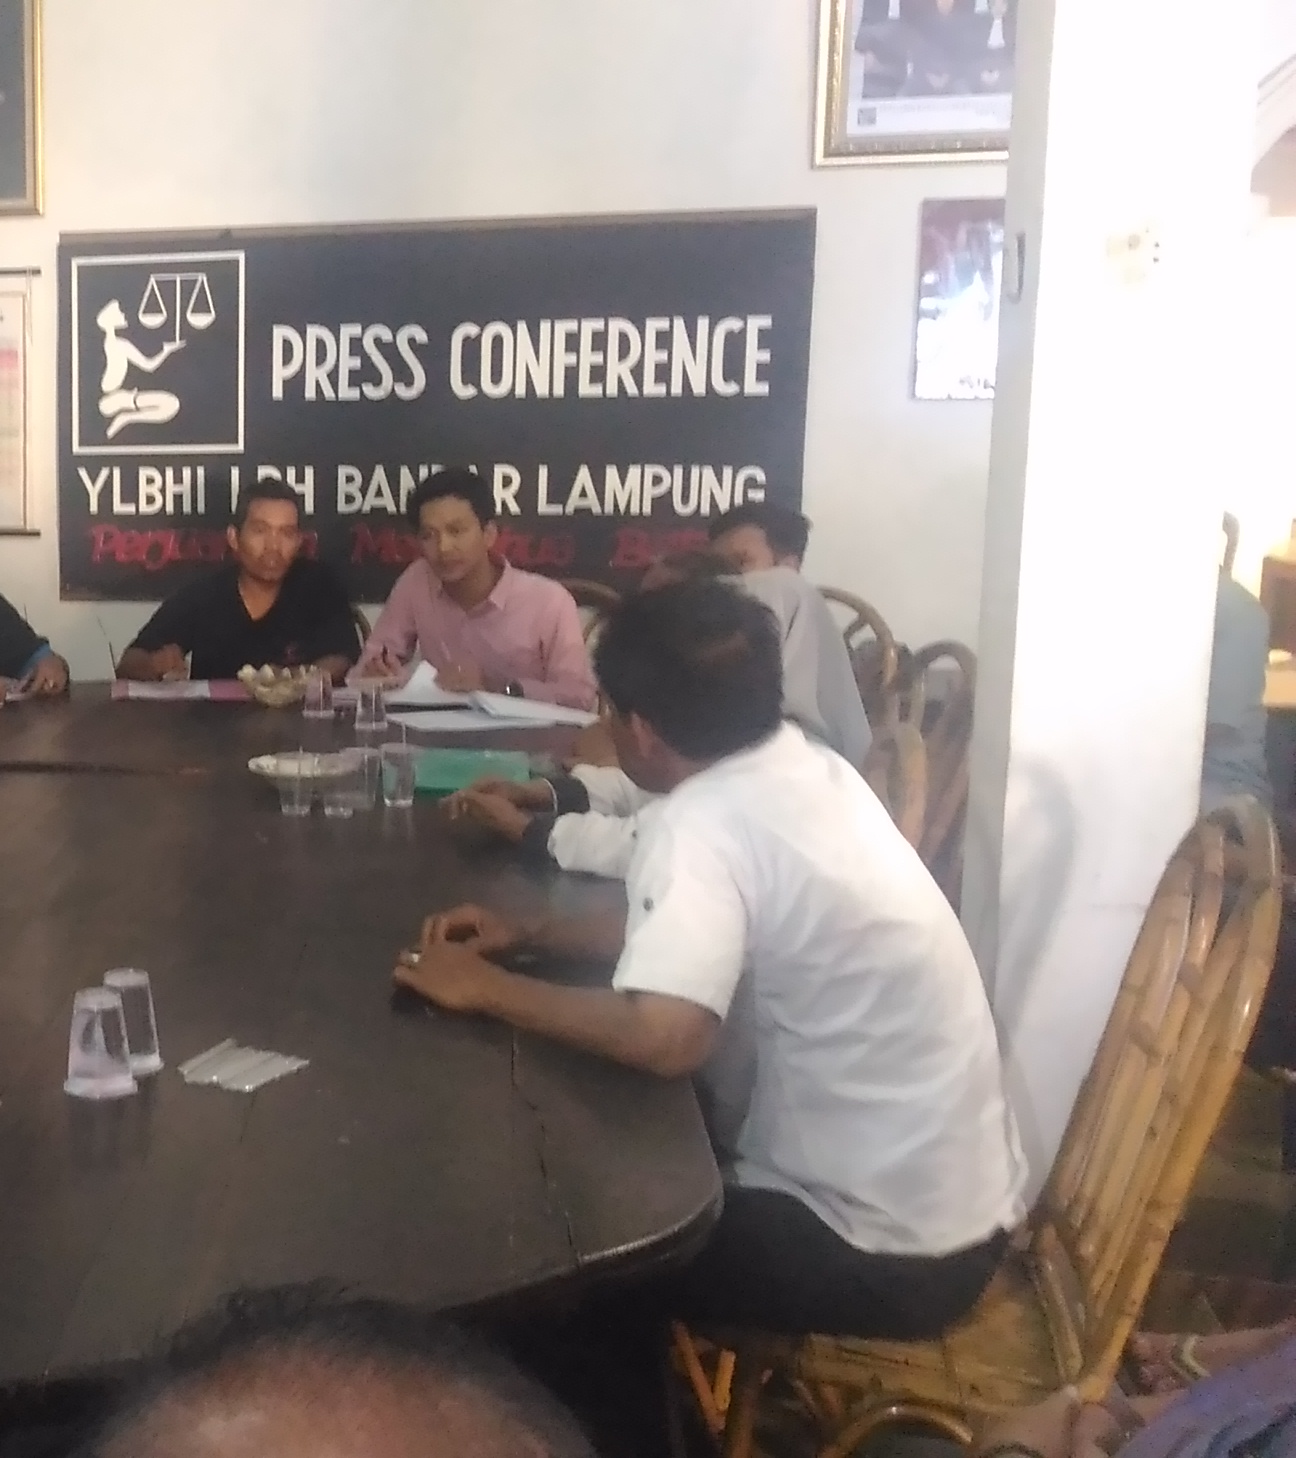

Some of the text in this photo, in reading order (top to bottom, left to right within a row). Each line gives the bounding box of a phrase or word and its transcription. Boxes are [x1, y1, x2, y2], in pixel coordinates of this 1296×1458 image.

[271, 315, 773, 401] PRESS CONFERENCE
[77, 465, 206, 516] YLBHI
[337, 463, 522, 516] BANR
